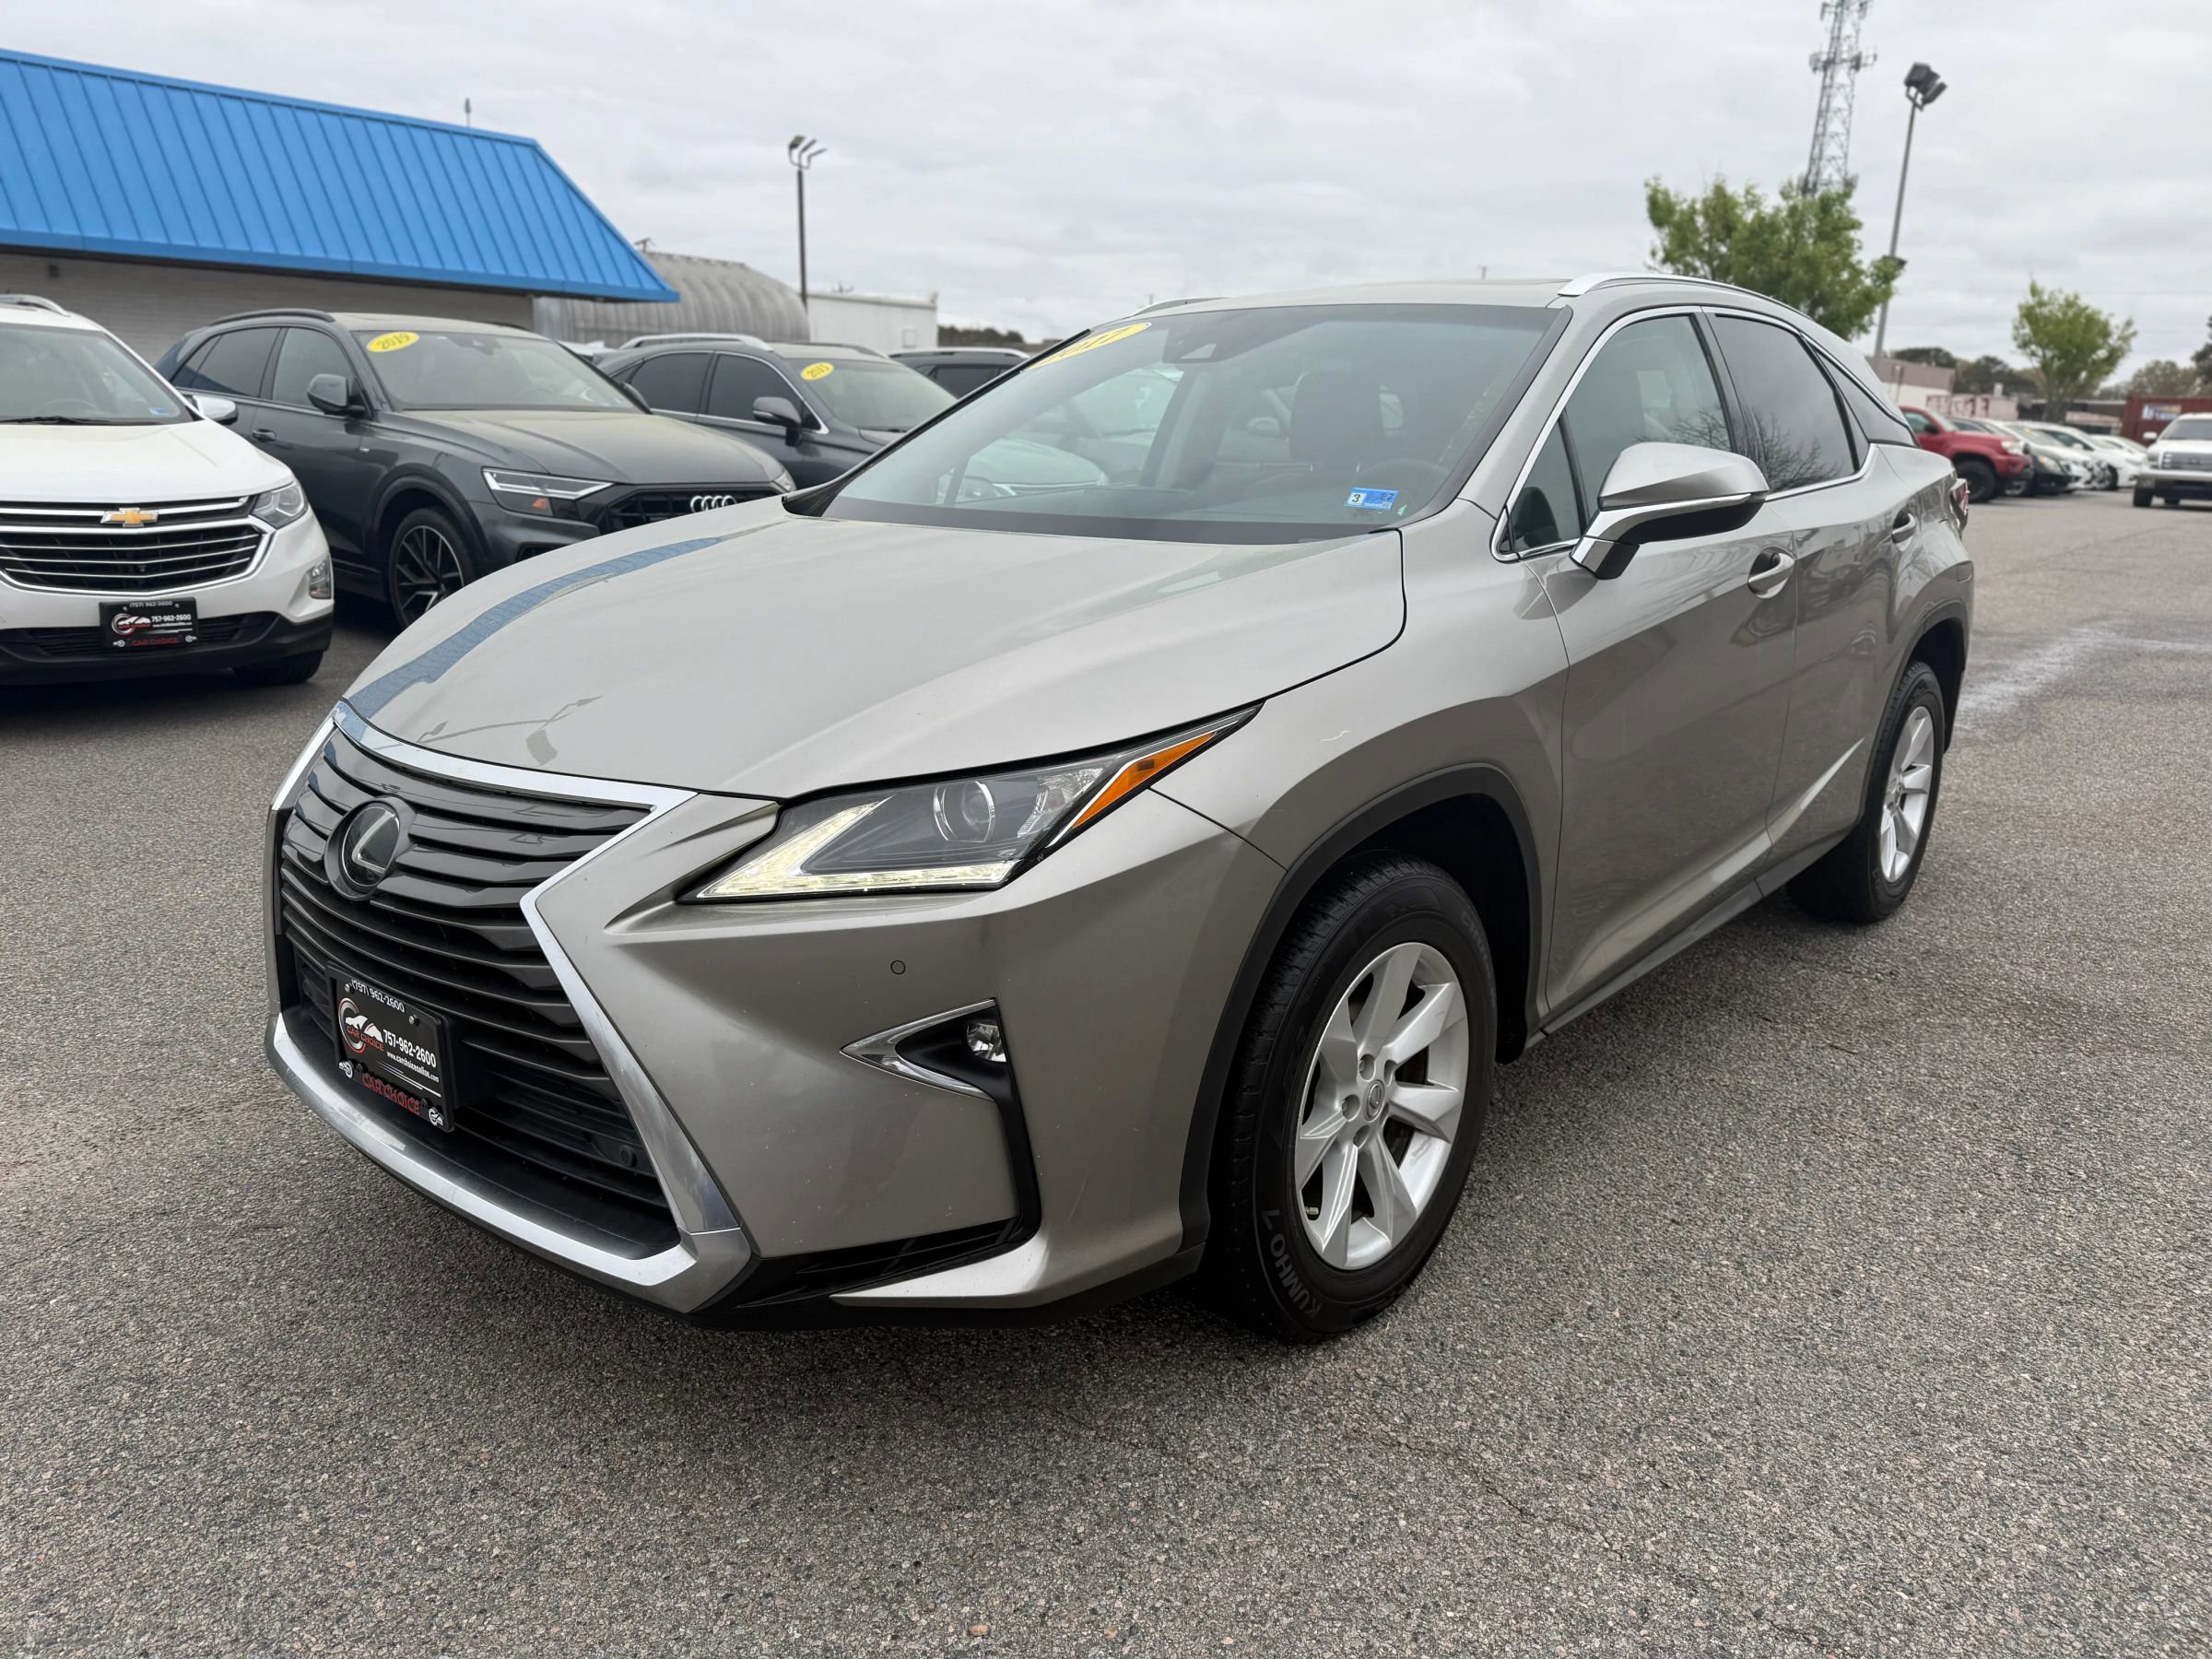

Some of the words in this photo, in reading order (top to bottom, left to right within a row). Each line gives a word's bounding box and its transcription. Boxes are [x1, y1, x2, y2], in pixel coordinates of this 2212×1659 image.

[1351, 493, 1361, 503] 3
[151, 614, 192, 623] 757-962-2600
[370, 986, 406, 1013] 962-2600
[347, 1026, 359, 1039] CAR
[360, 1031, 384, 1052] CHOICE
[382, 1029, 437, 1068] 757-962-2600
[361, 1073, 382, 1094] CAR
[383, 1085, 421, 1115] CHOICE
[1271, 1233, 1324, 1318] KUMHO
